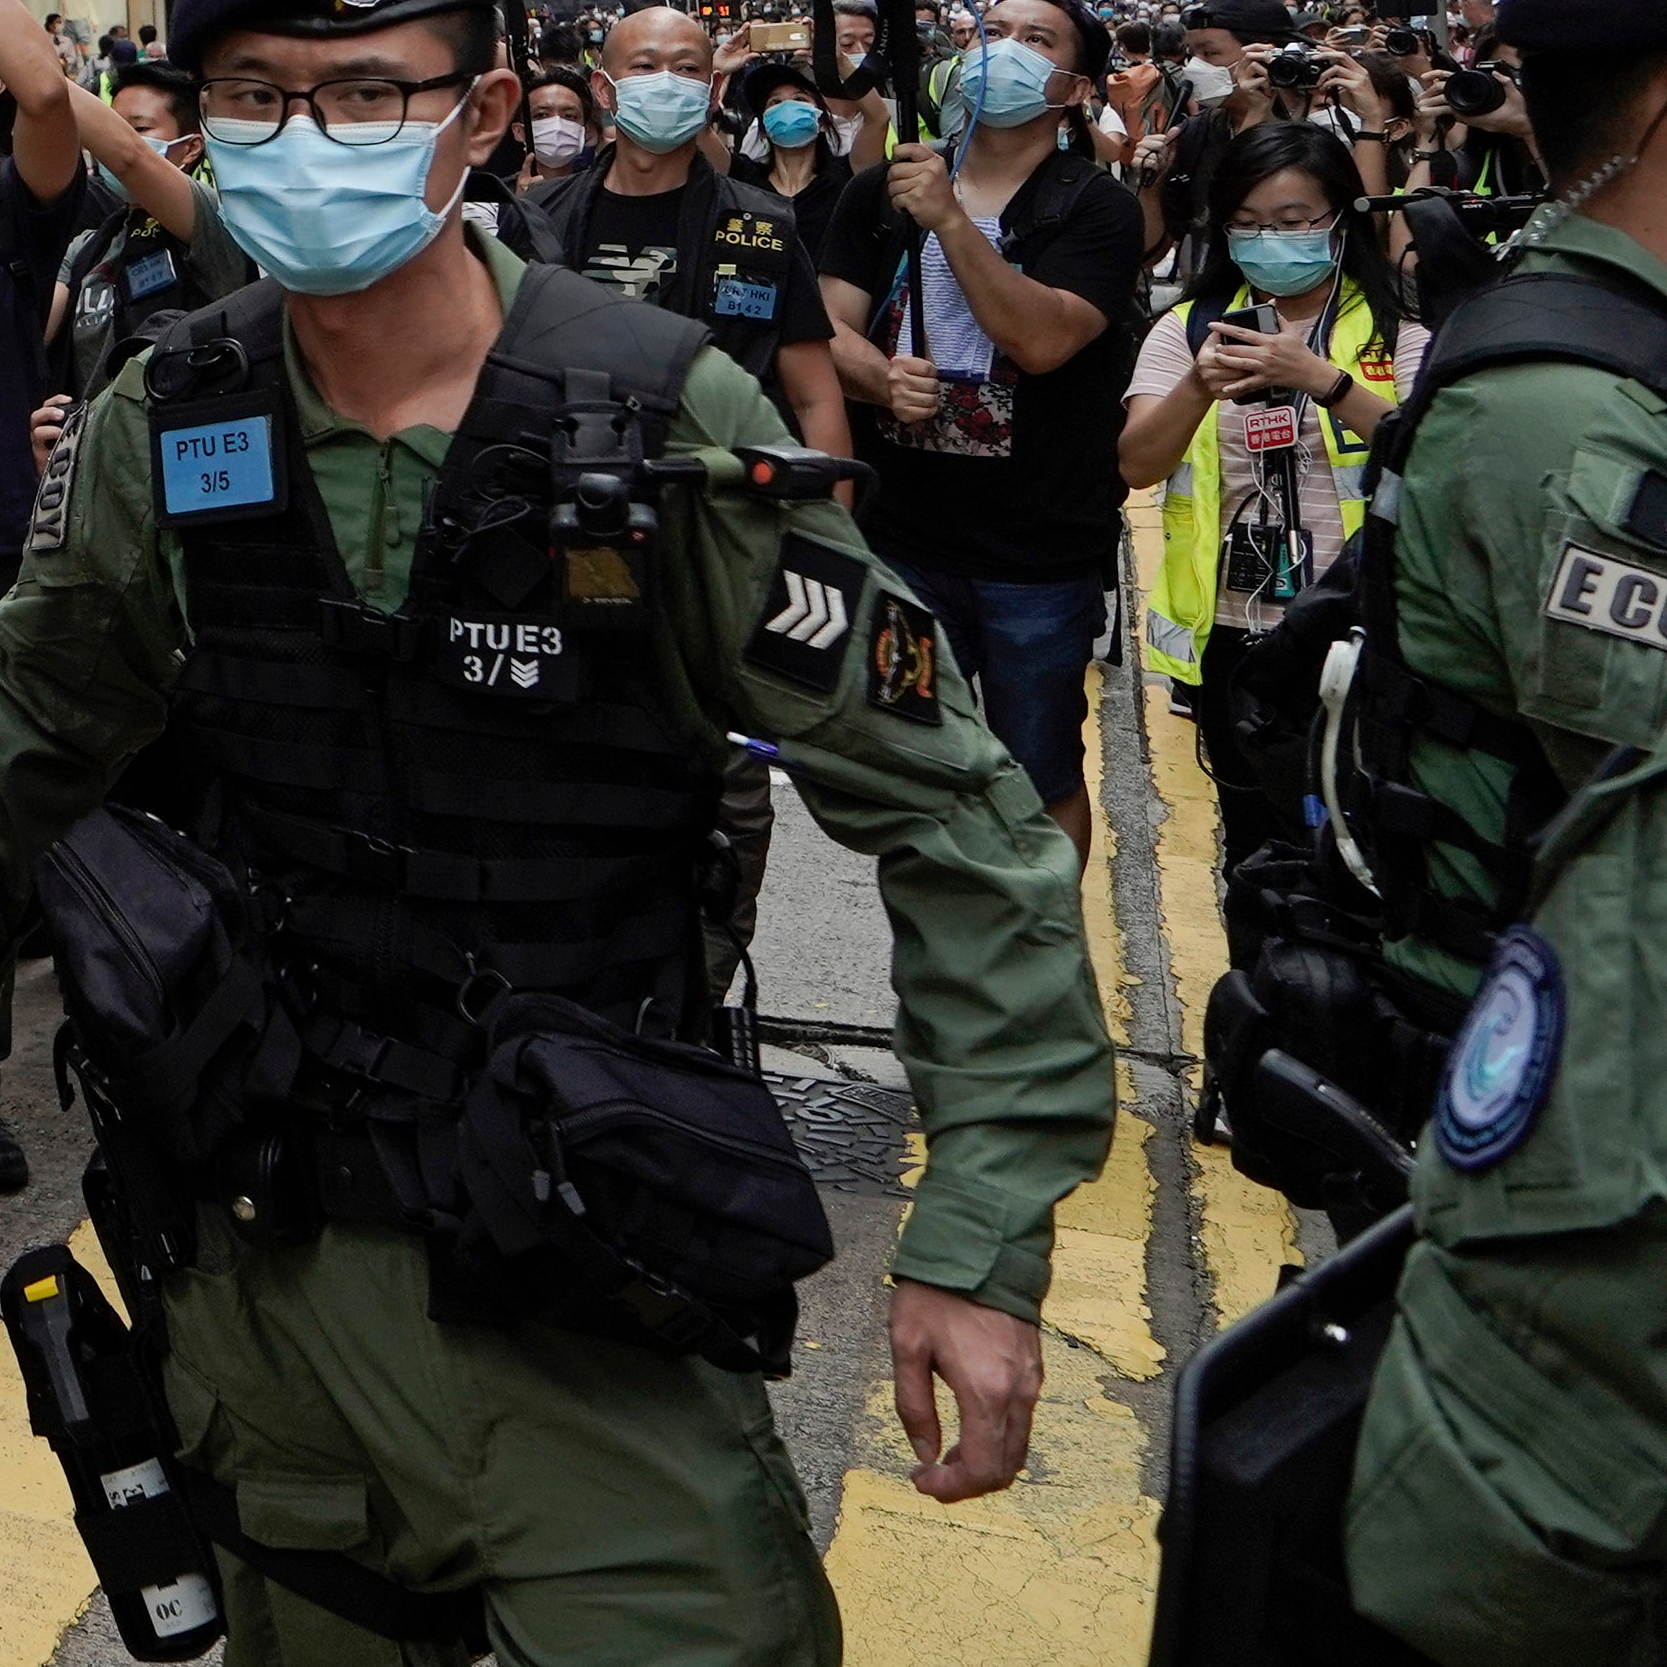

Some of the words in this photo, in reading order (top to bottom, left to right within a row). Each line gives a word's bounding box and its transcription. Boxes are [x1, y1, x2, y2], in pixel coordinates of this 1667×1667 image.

[715, 230, 784, 252] POLICE
[750, 290, 772, 303] HKI
[1250, 413, 1288, 430] RTHK
[174, 433, 217, 459] PTU
[220, 431, 250, 455] E3
[199, 467, 232, 494] 3/5
[1559, 555, 1605, 615] E
[448, 618, 509, 654] PTU
[513, 620, 564, 657] E3
[155, 1598, 183, 1622] OC
